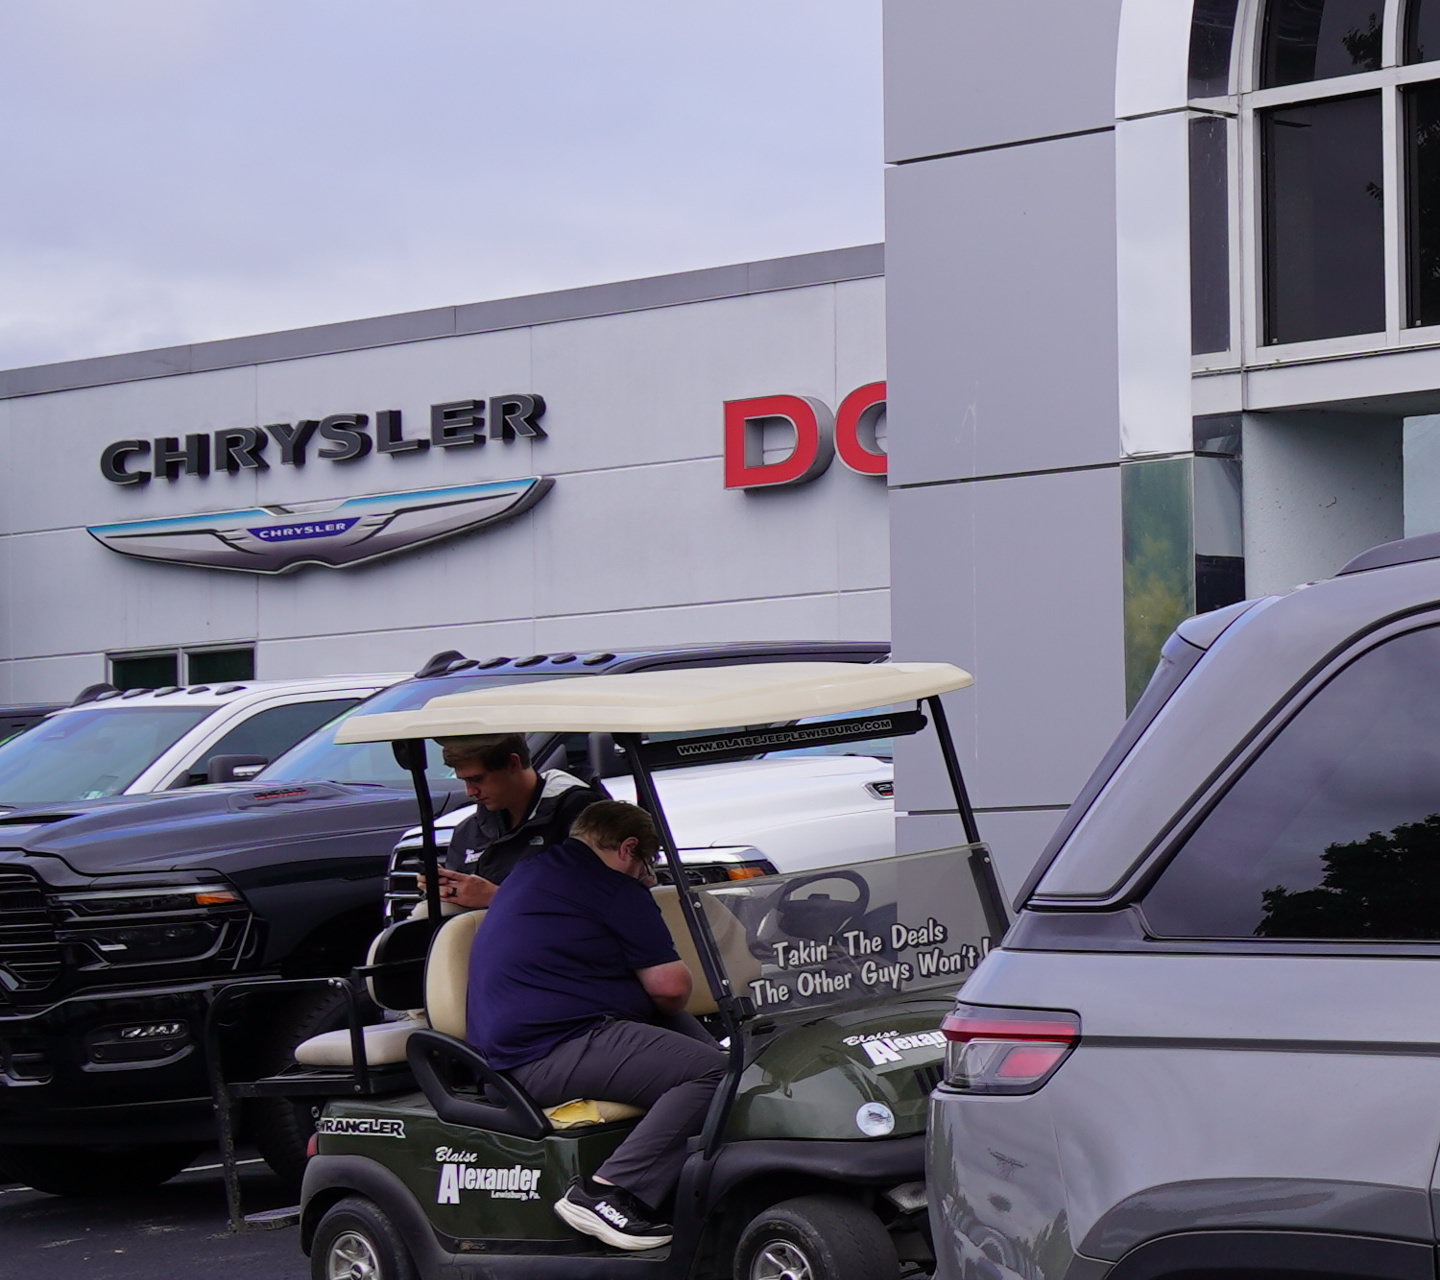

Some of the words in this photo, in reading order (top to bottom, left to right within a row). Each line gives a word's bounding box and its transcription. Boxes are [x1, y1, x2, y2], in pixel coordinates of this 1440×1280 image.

[100, 392, 548, 487] CHRYSLER
[258, 522, 346, 538] CHRYSLER
[677, 719, 892, 756] WWW.BLAISEJEEPLEWISBURG.COM
[772, 935, 834, 969] Takin'
[843, 930, 882, 957] The
[891, 918, 945, 950] Deals
[749, 979, 790, 1006] The
[797, 970, 853, 997] Other
[861, 960, 911, 990] Guys
[917, 944, 977, 976] Won't
[843, 1030, 900, 1046] Blaise
[435, 1146, 479, 1163] Blaise
[437, 1163, 542, 1205] Alexander
[594, 1201, 629, 1228] HOKA
